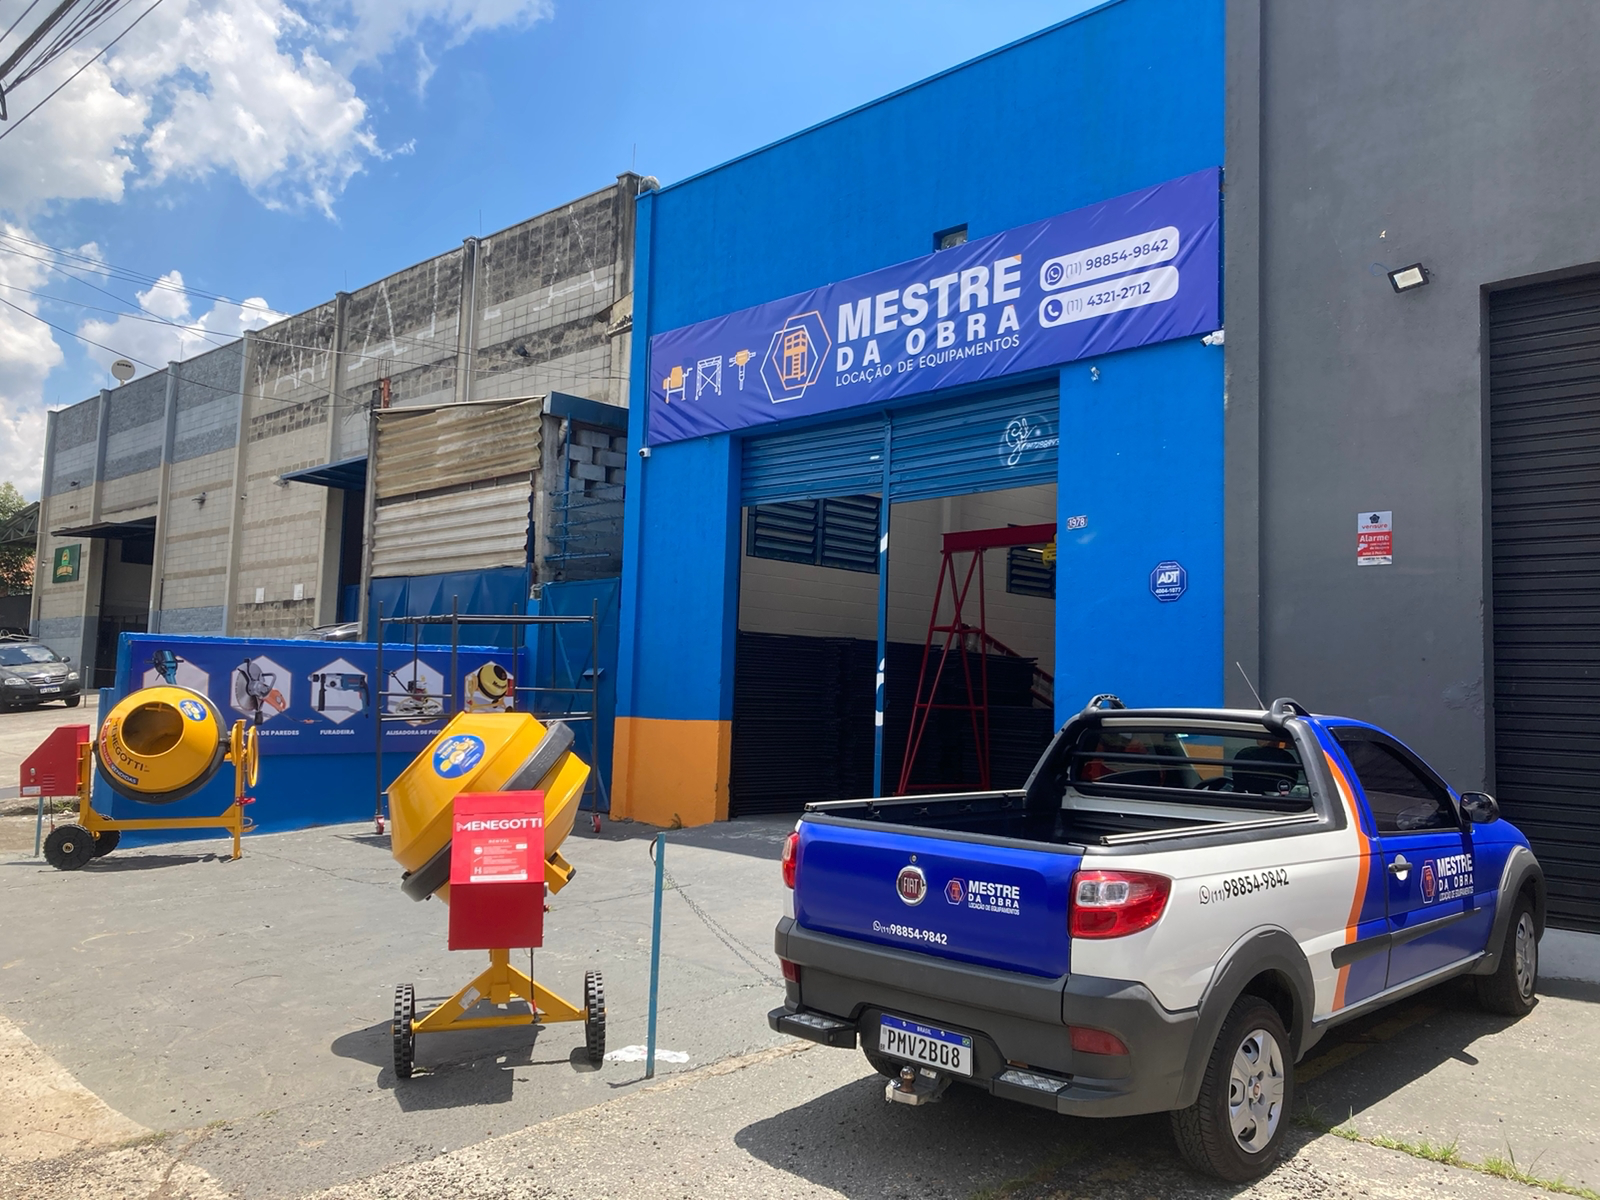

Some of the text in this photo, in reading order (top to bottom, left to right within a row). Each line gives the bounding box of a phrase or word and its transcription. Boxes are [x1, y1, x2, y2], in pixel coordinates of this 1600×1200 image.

[1065, 238, 1169, 279] (11) 98854-9842
[837, 253, 1023, 344] MESTRE
[1066, 281, 1151, 315] (11) 4321-2712
[836, 304, 1020, 373] DA OBRA
[835, 333, 1020, 388] LOCAÇÃO DE EQUIPAMENTOS
[1359, 534, 1390, 543] Alarme
[1157, 570, 1180, 584] ADT
[456, 818, 543, 832] MENEGOTTI
[1437, 853, 1473, 877] MESTRE
[903, 877, 919, 895] FIAT
[968, 880, 1020, 899] MESTRE
[1439, 873, 1474, 891] DA OBRA
[968, 893, 1019, 909] DA OBRA
[917, 1026, 932, 1035] BRASIL
[888, 1029, 960, 1068] PMV2B08
